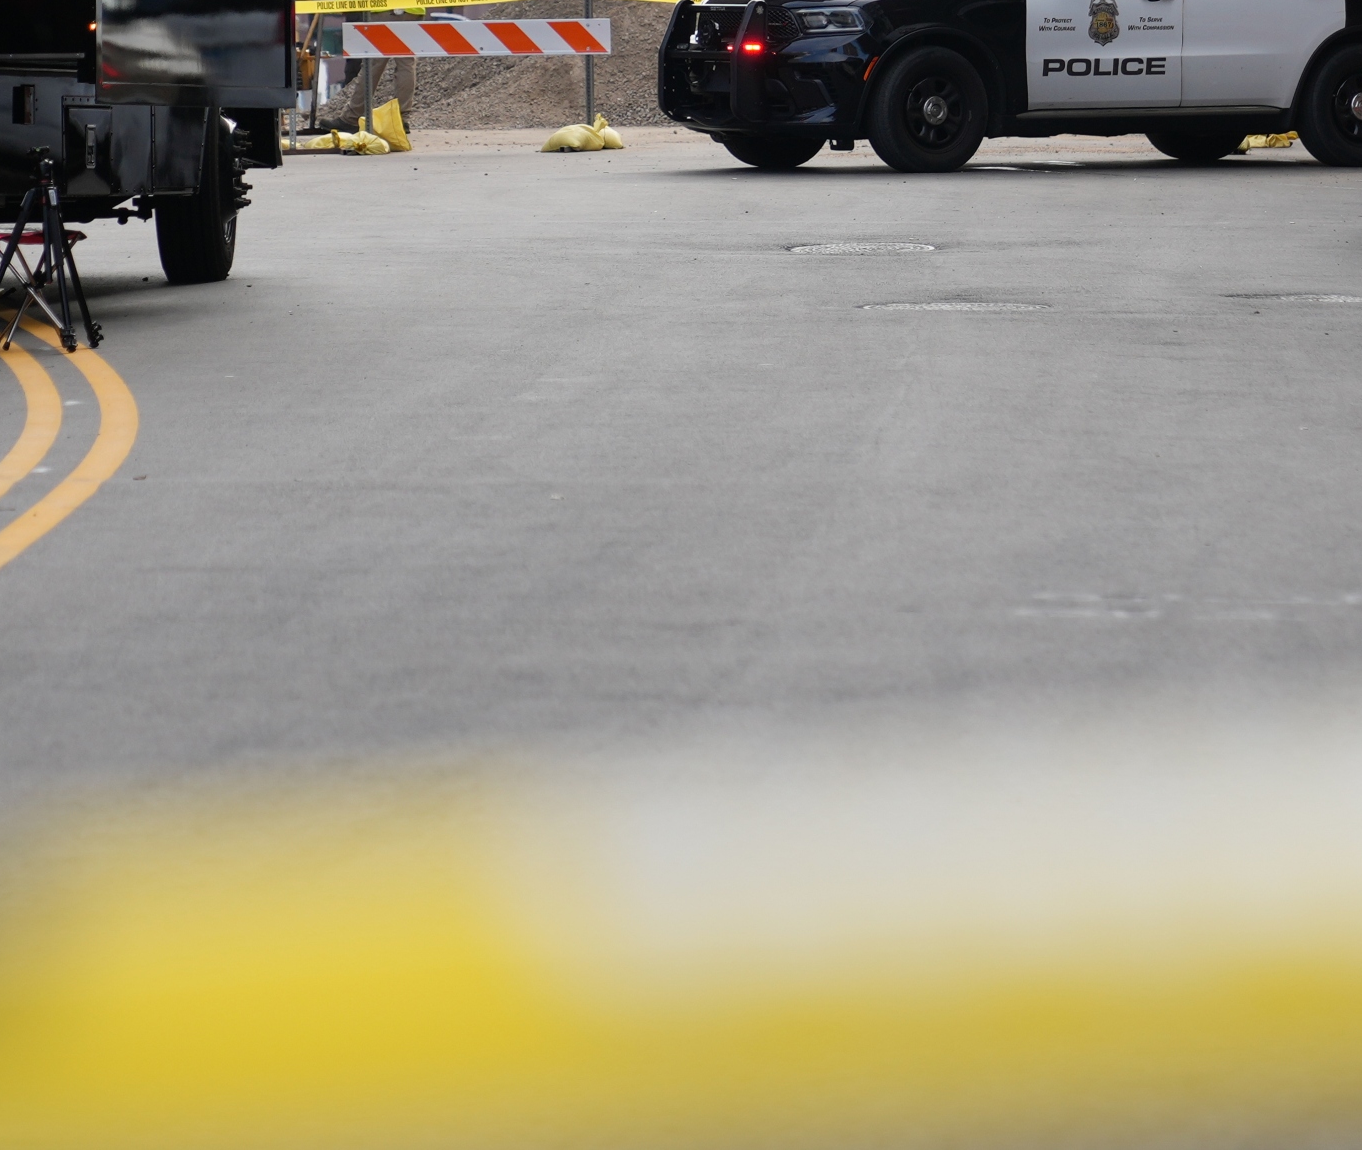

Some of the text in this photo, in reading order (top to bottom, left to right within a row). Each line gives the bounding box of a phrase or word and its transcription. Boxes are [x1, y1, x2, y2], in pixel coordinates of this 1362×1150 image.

[317, 0, 387, 10] POLICE LINE DO NOT CROSS
[1042, 57, 1167, 77] POLICE
